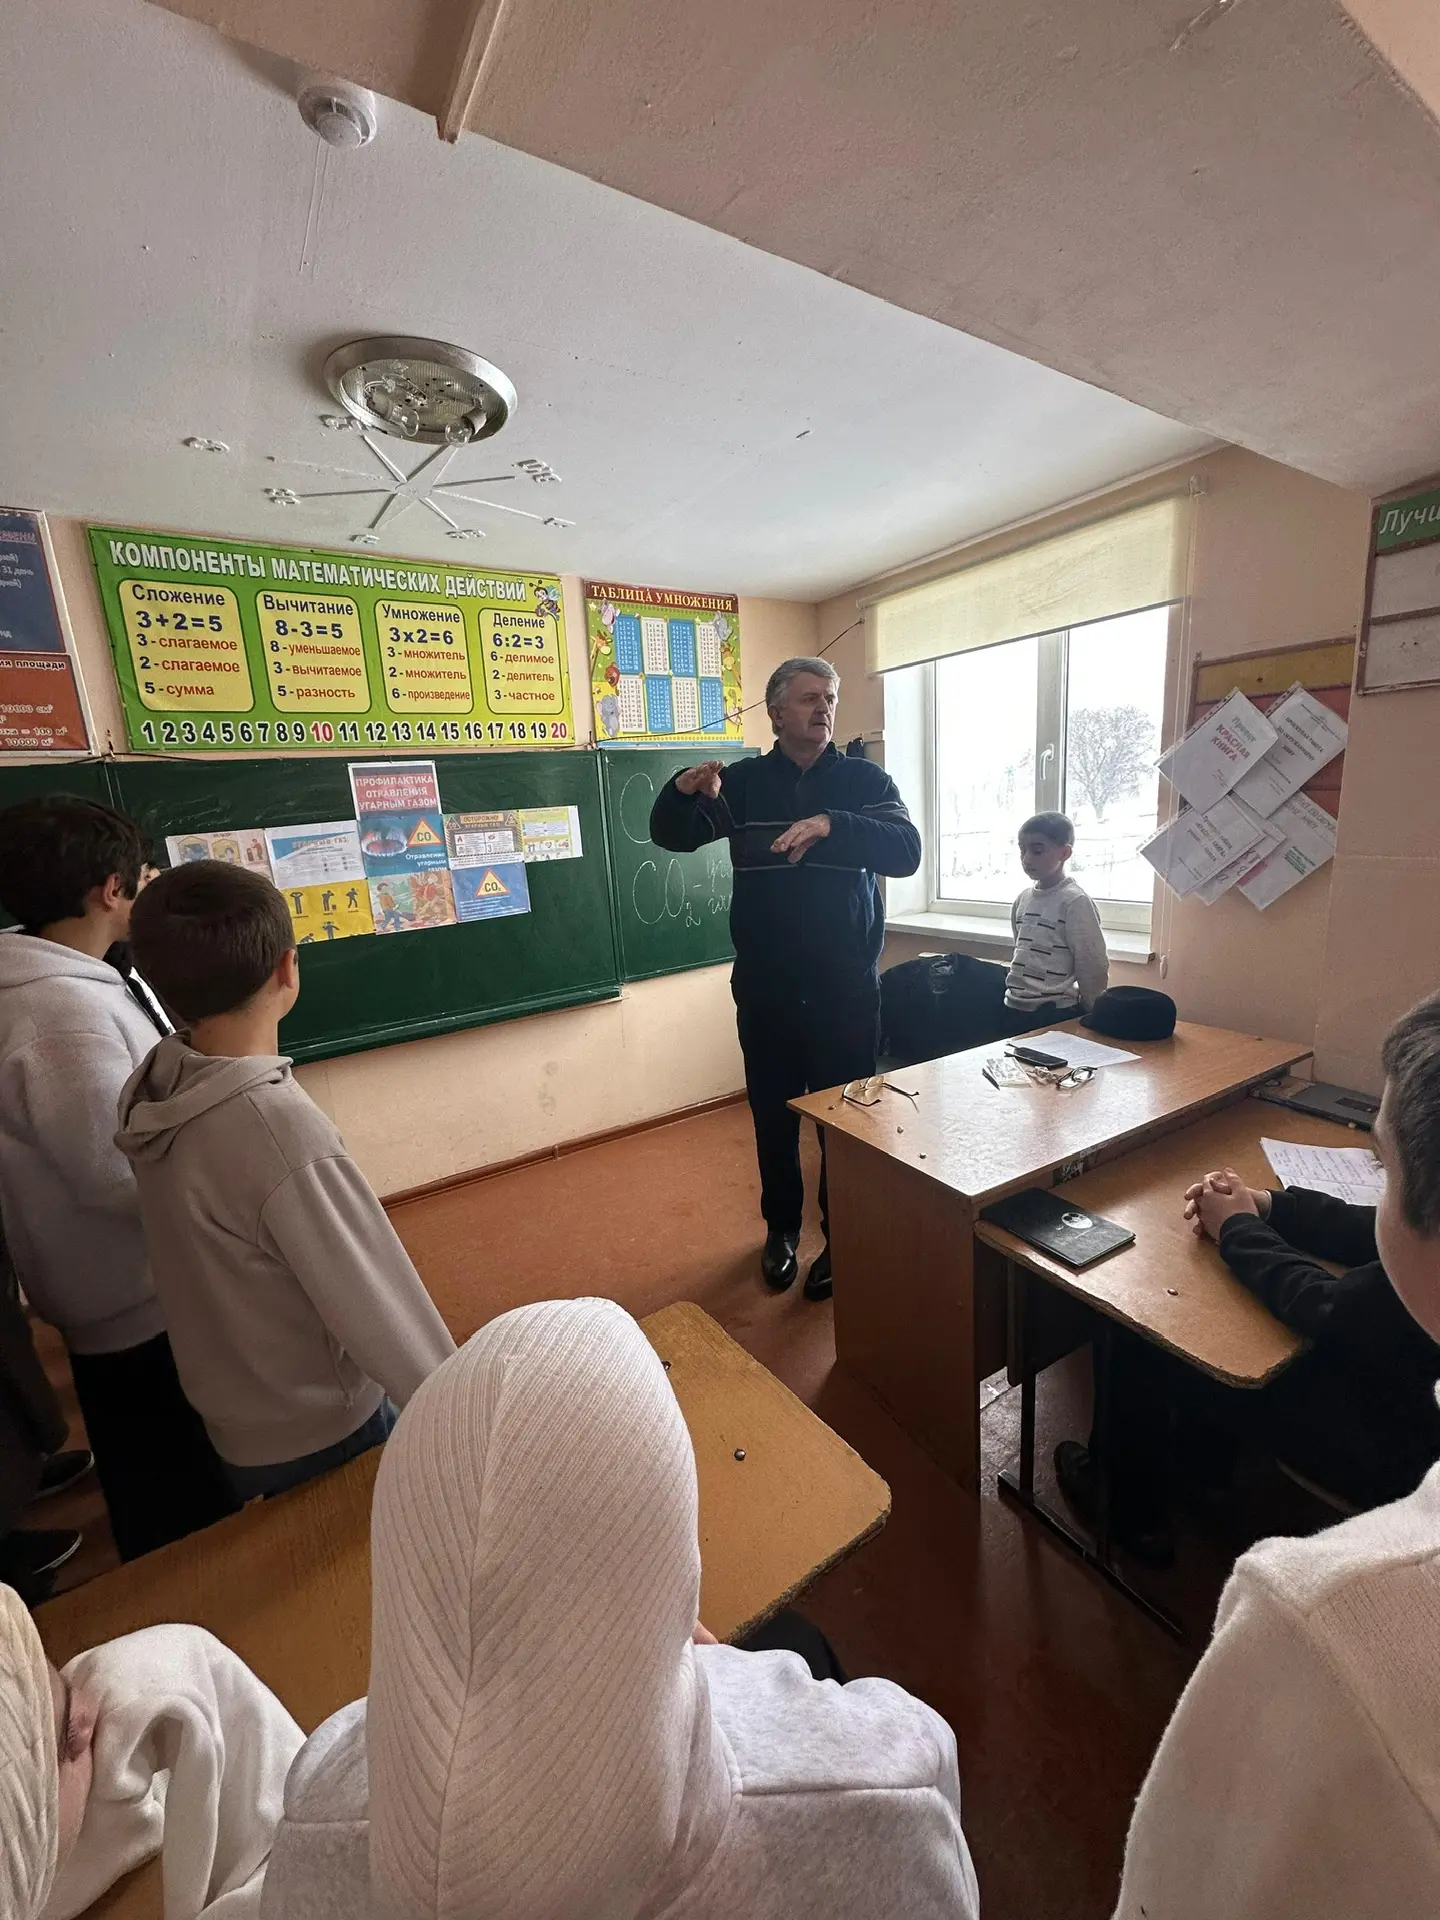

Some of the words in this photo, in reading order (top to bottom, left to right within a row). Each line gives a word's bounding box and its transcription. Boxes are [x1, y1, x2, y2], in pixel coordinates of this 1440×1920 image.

[109, 540, 266, 579] КОМПОНЕНТЫ
[271, 557, 441, 593] МАТЕМАТИЧЕСКИХ
[445, 575, 527, 602] ДЕЙСТВИЙ
[132, 584, 226, 606] Сложение
[591, 584, 653, 603] ТАБЛИЦА
[656, 592, 732, 611] УМНОЖЕНИЯ
[263, 594, 354, 616] Вычитание
[382, 604, 460, 624] Умножение
[493, 612, 545, 629] Деление
[159, 636, 238, 651] слагаемое
[289, 644, 360, 656] уменьшаемое
[404, 650, 466, 661] множитель
[505, 653, 554, 664] делимое
[15, 660, 66, 671] площади
[162, 659, 240, 673] слагаемое
[292, 664, 362, 677] вычитаемое
[406, 670, 466, 680] множитель
[506, 672, 554, 682] делитель
[166, 685, 214, 698] сумма
[296, 688, 356, 699] разность
[408, 690, 470, 702] произведение
[510, 692, 555, 701] частное
[142, 721, 154, 743] 1
[162, 721, 177, 743] 2
[182, 721, 197, 743] 3
[202, 721, 216, 743] 4
[221, 721, 235, 743] 5
[239, 721, 253, 743] 6
[257, 721, 270, 743] 7
[275, 721, 289, 743] 8
[292, 721, 306, 743] 9
[310, 721, 334, 743] 10
[338, 721, 360, 743] 11
[365, 721, 388, 743] 12
[391, 722, 412, 741] 13
[416, 722, 437, 741] 14
[441, 722, 460, 741] 15
[465, 722, 483, 741] 16
[487, 722, 504, 741] 17
[509, 722, 527, 741] 18
[530, 722, 547, 741] 19
[551, 722, 568, 741] 20
[1211, 736, 1238, 761] КНИГА
[1216, 724, 1252, 760] КРАСНАЯ
[356, 776, 434, 787] ПРОФИЛАКТИКА
[366, 788, 428, 798] ОТРАВЛЕНИЯ
[358, 800, 405, 811] УГАРНЫМ
[407, 798, 436, 808] ГАЗОМ
